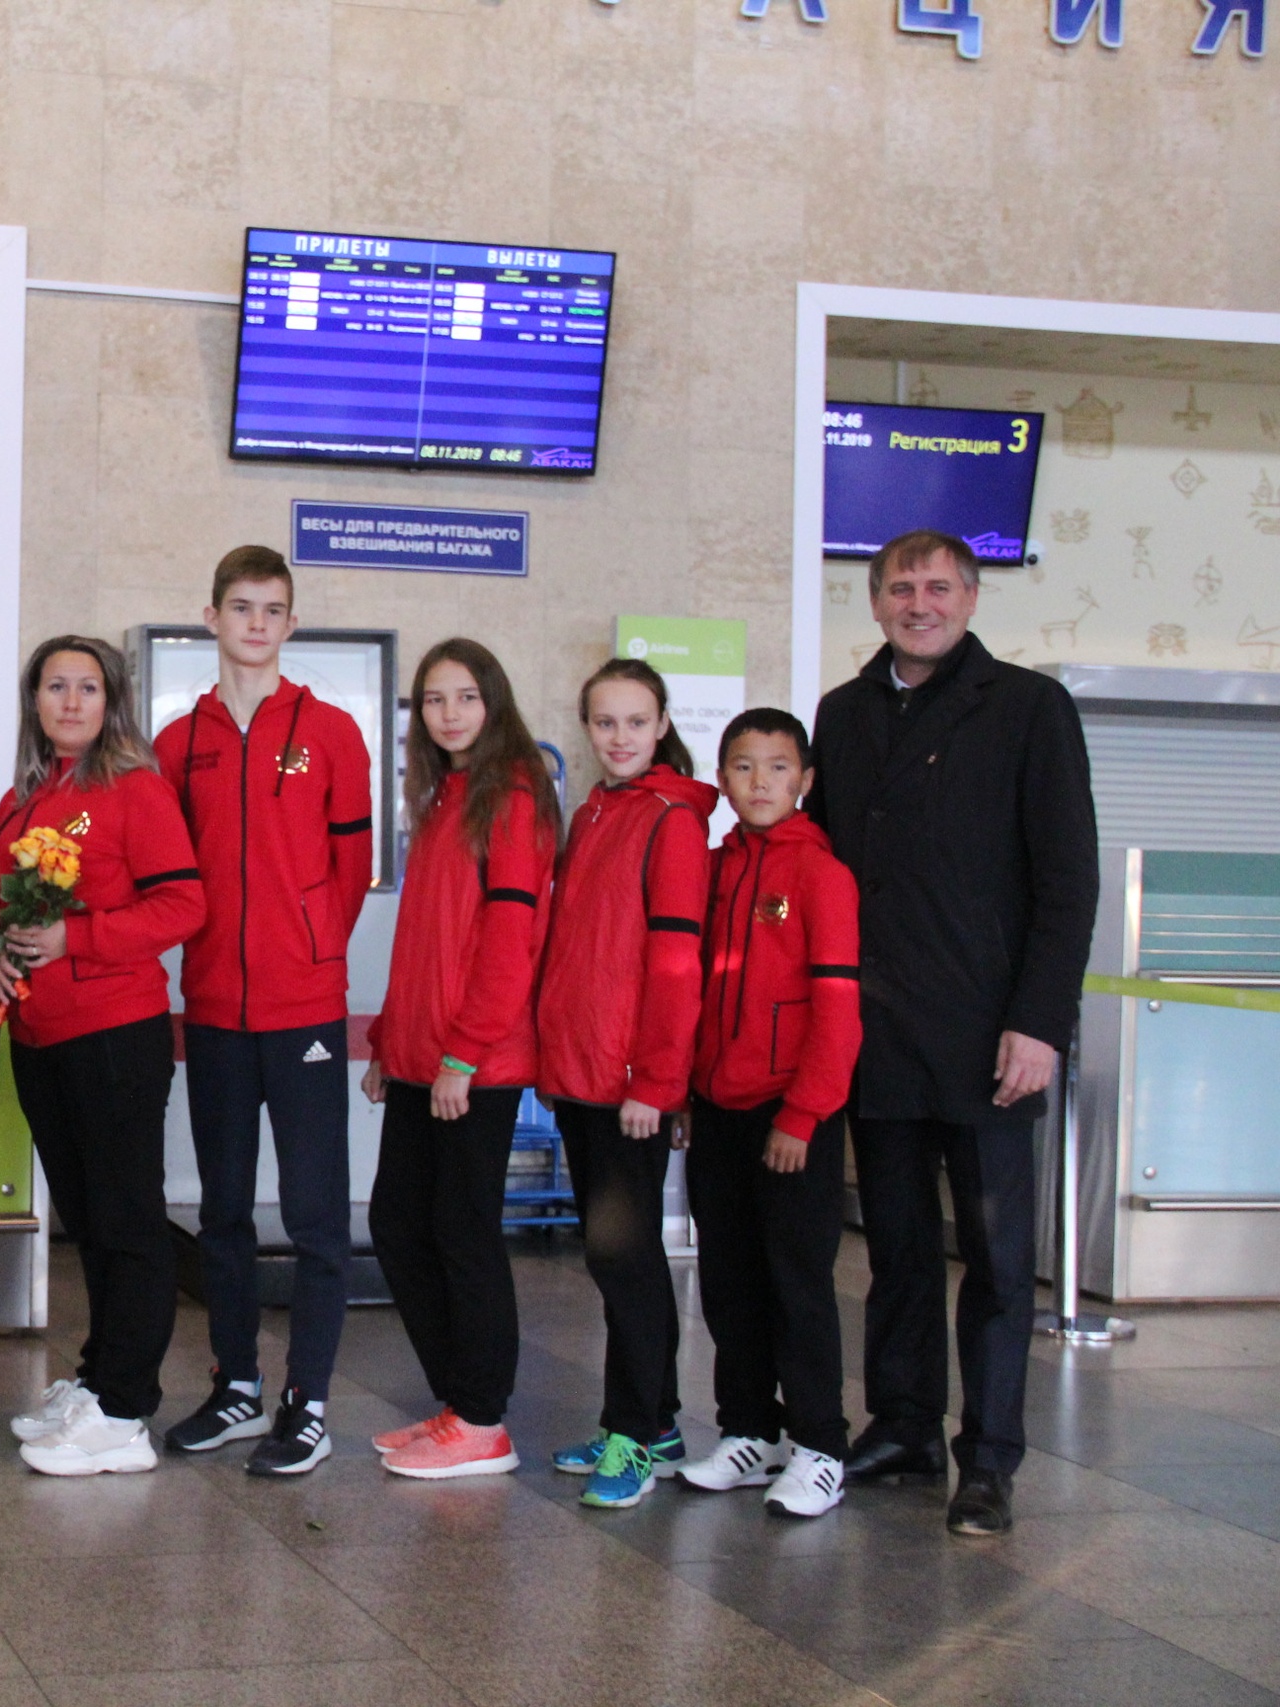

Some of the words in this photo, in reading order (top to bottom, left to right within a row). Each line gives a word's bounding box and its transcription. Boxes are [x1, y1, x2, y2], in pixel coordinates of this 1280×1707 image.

[295, 235, 390, 257] ПРИЛЕТЫ
[487, 249, 561, 268] ВЫЛЕТЫ
[889, 431, 1001, 456] Регистрация
[1007, 418, 1030, 453] 3
[530, 458, 593, 469] АБАКАН
[301, 517, 343, 532] ВЕСЫ
[344, 519, 375, 534] ДЛЯ
[376, 520, 521, 541] ПРЕДВАРИТЕЛЬНОГО
[329, 536, 435, 553] ВЗВЕШИВАНИЯ
[437, 541, 493, 557] БАГАЖА
